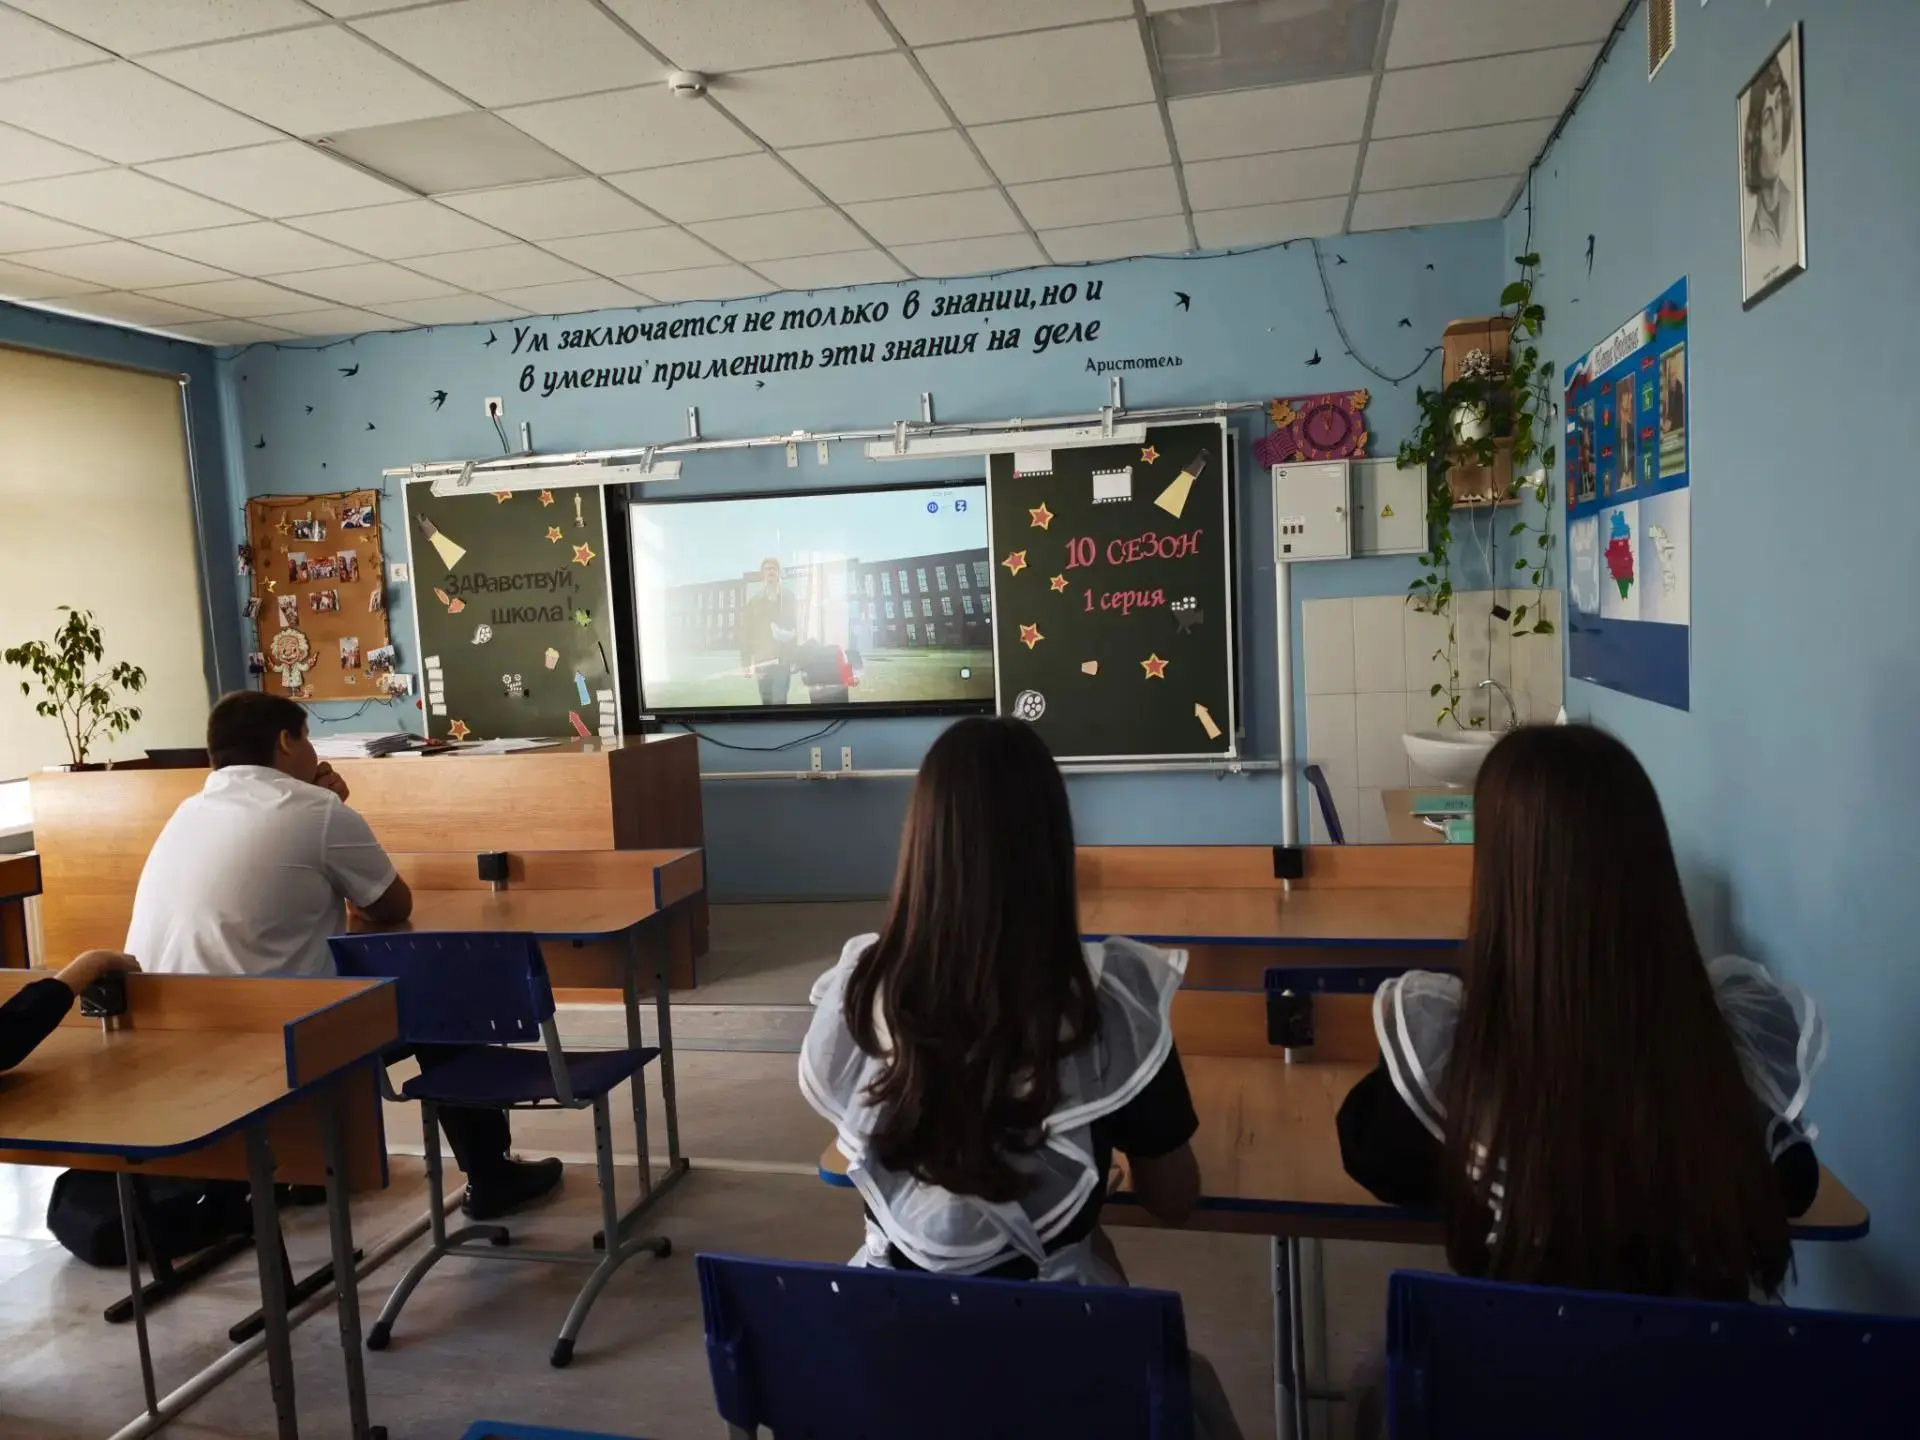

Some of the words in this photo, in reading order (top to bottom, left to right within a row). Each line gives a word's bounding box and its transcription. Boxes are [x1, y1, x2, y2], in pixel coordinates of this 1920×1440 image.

[511, 326, 550, 354] Ум
[558, 313, 739, 351] заключается
[742, 311, 776, 333] не
[779, 302, 890, 331] только
[902, 289, 921, 319] в
[931, 287, 1037, 318] знании,
[1038, 283, 1077, 306] но
[1085, 280, 1103, 302] и
[519, 364, 536, 392] в
[540, 363, 644, 397] умении
[651, 350, 815, 391] применить
[819, 343, 876, 369] эти
[880, 331, 979, 362] знания
[985, 327, 1021, 351] на
[1031, 320, 1101, 355] деле
[1084, 355, 1183, 377] Аристотель
[1065, 536, 1097, 570] 10
[1106, 529, 1204, 566] СЕЗОН
[1083, 589, 1095, 612] 1
[1101, 588, 1166, 616] серия
